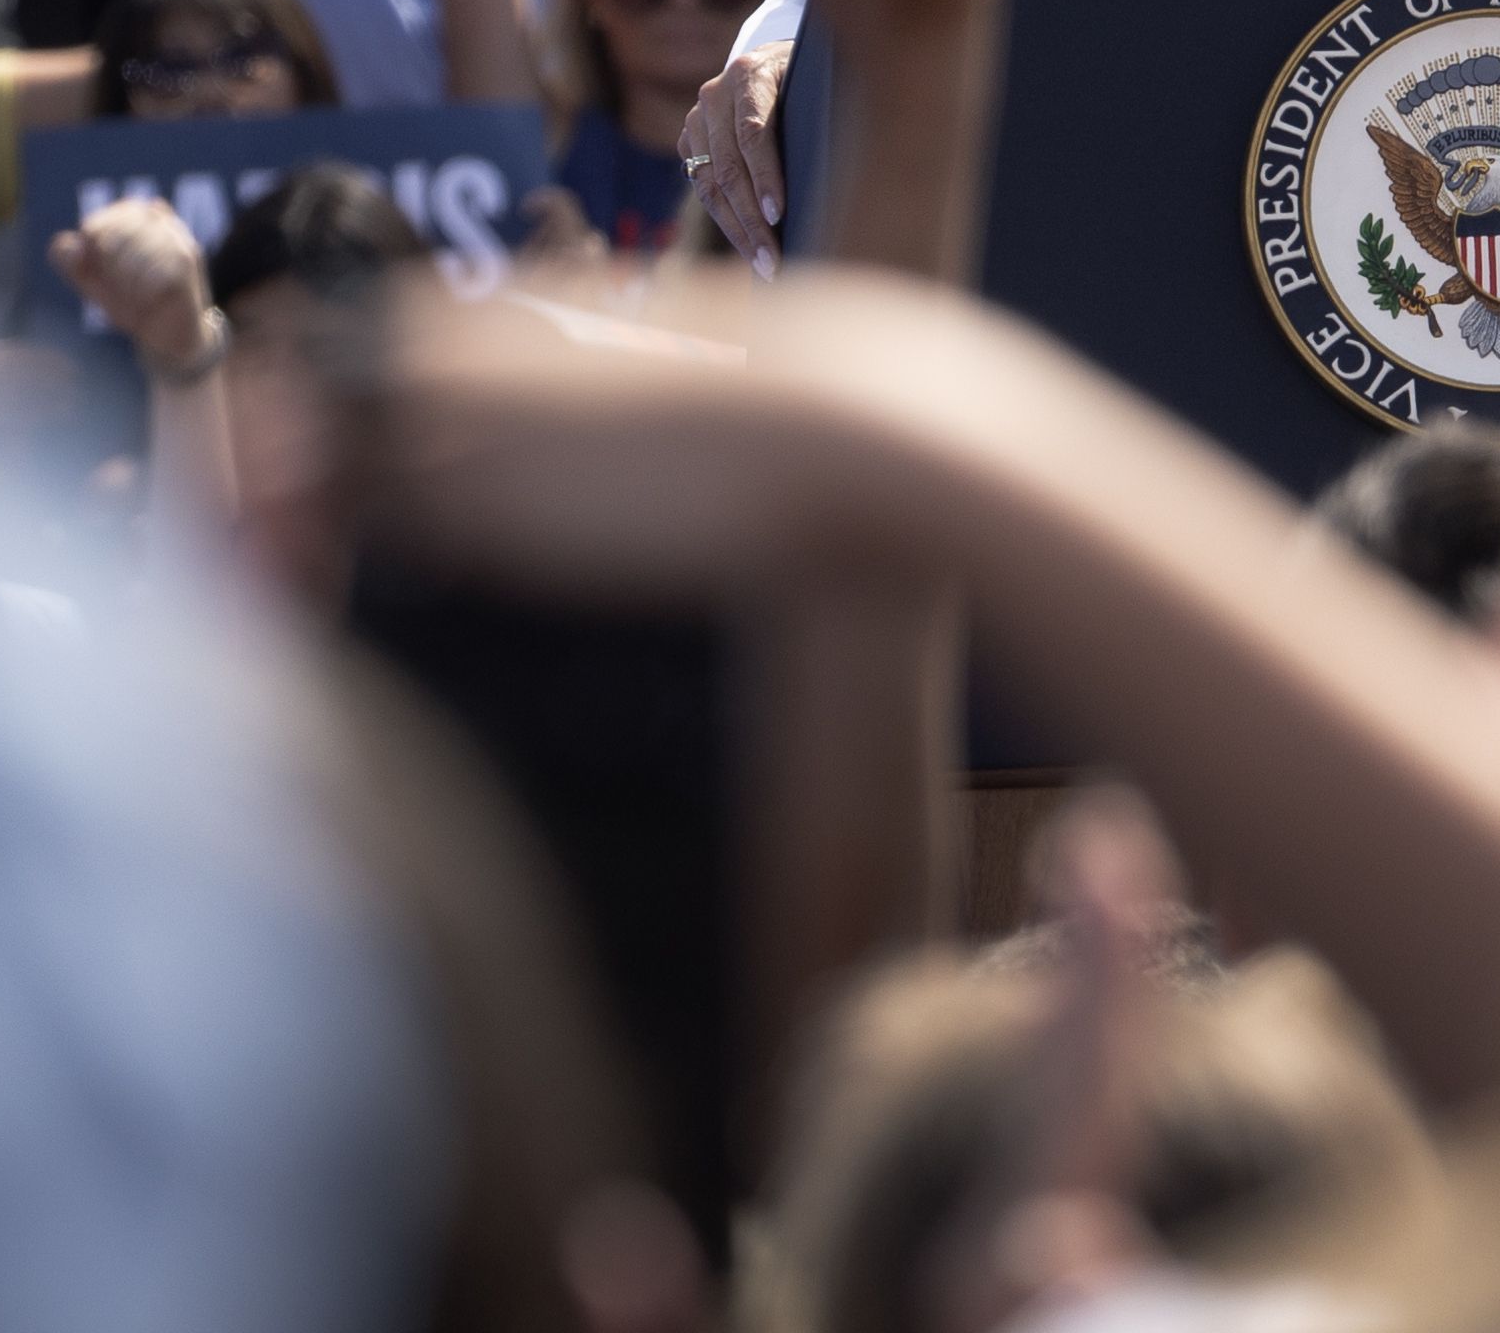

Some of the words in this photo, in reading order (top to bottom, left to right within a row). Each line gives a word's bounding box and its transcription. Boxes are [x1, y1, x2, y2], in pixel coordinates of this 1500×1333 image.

[1255, 4, 1384, 298] PRESIDENT
[1432, 138, 1446, 155] E
[1306, 310, 1421, 425] VICE
